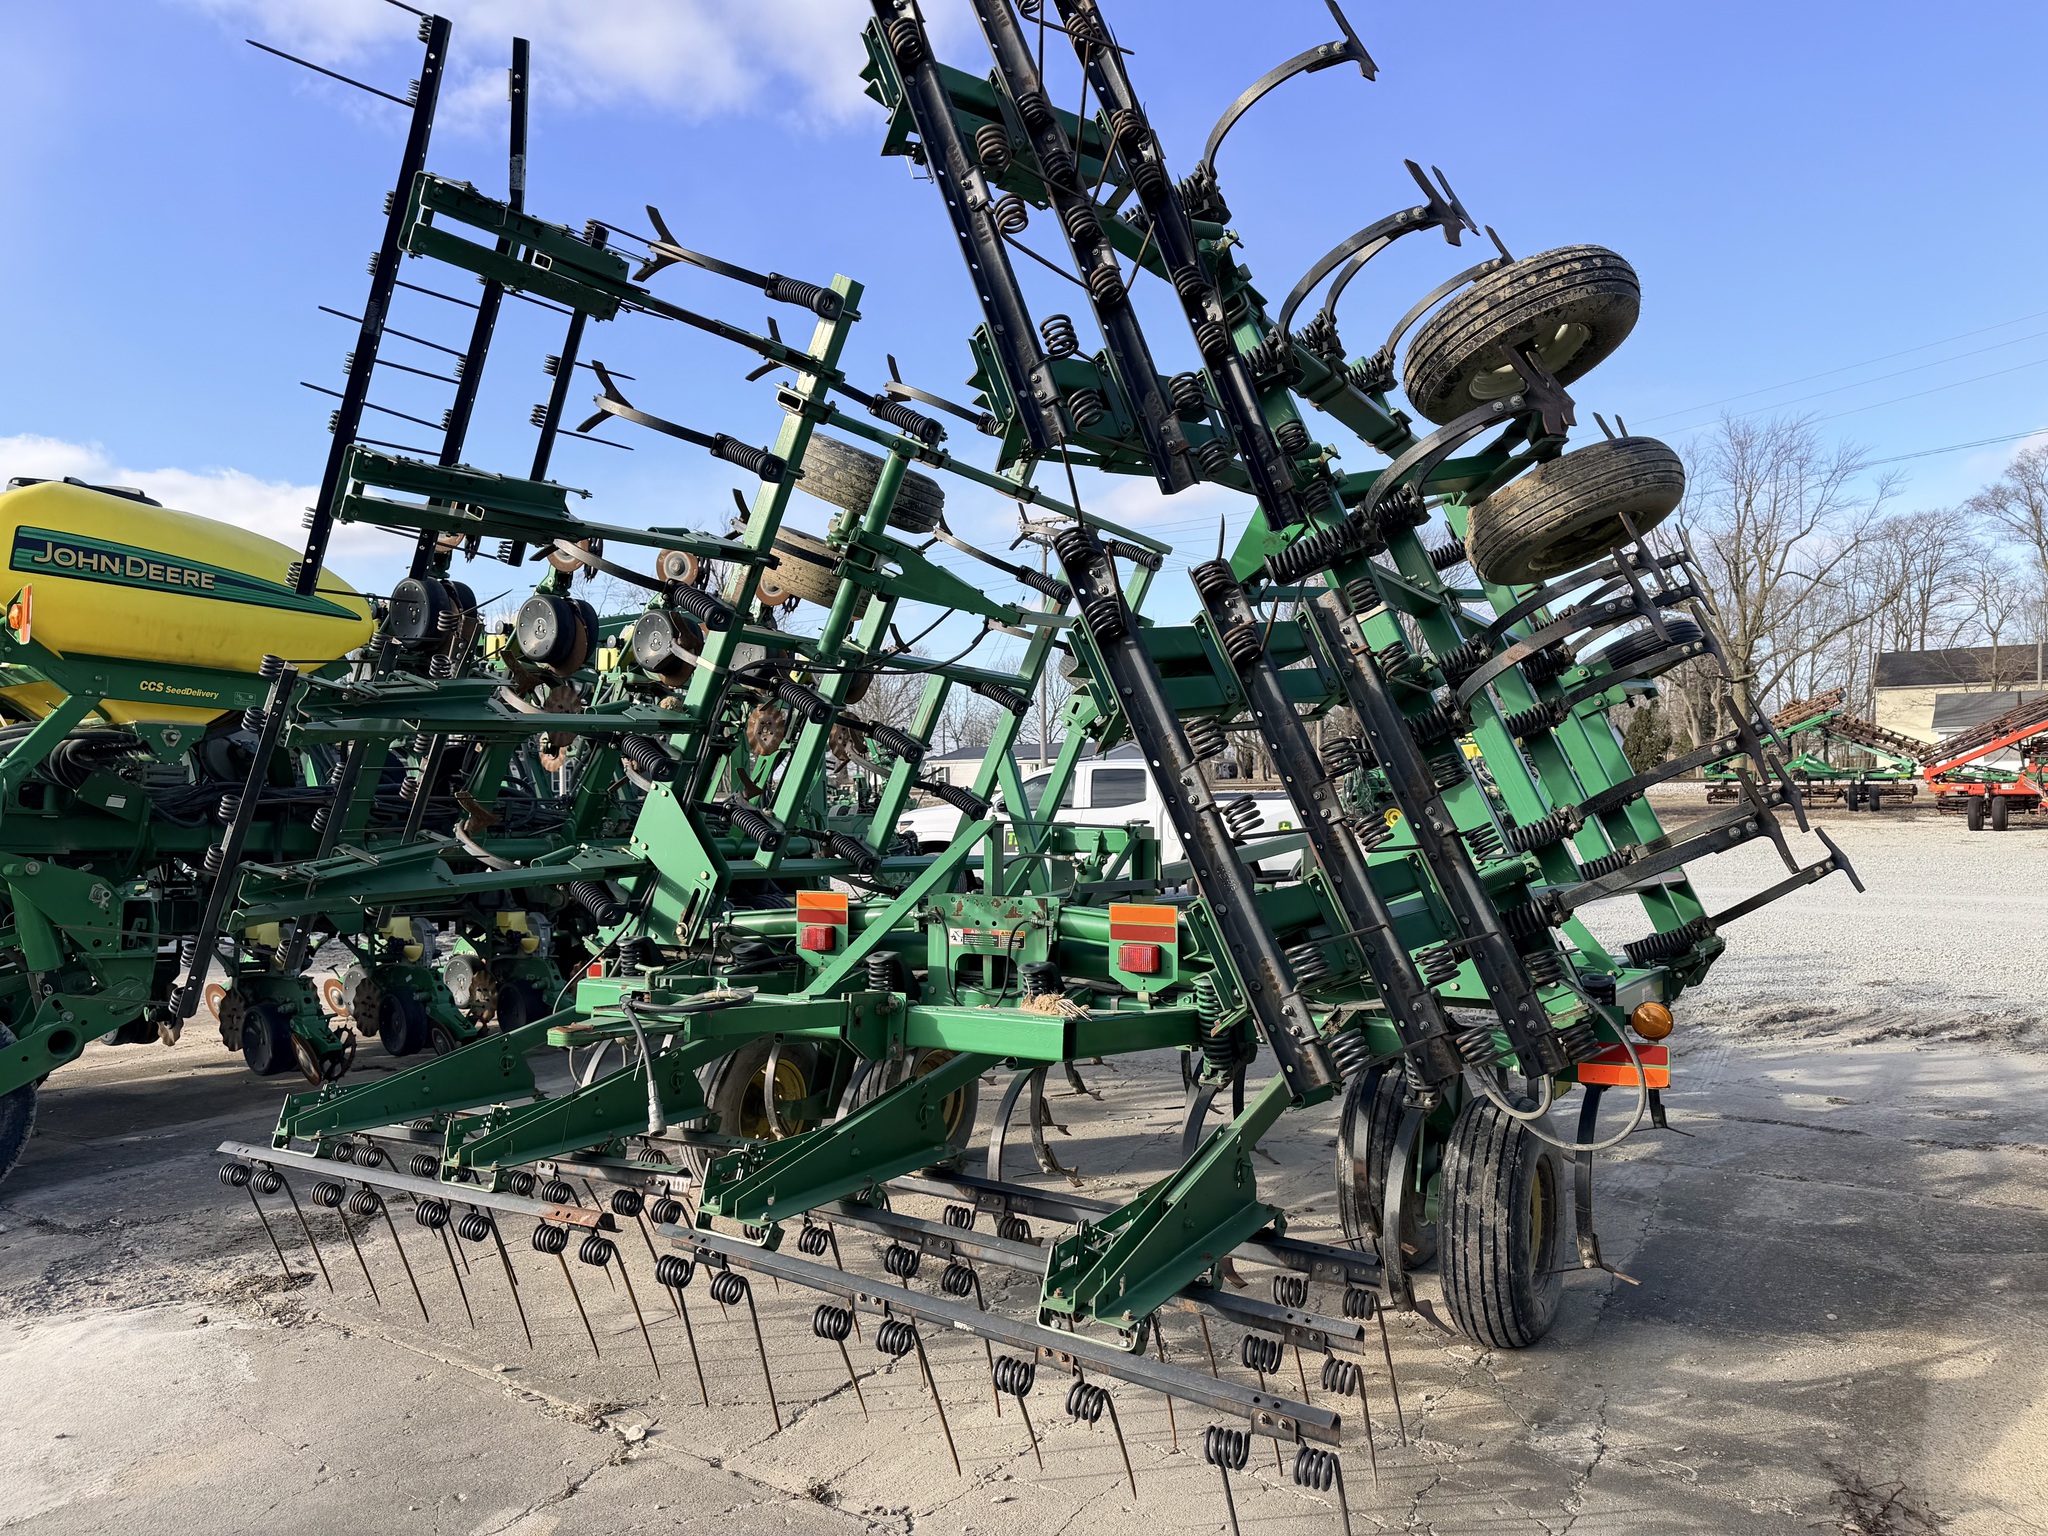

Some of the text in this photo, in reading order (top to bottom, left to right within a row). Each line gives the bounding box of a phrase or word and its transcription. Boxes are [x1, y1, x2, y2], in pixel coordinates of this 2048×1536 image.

[34, 541, 216, 590] JOHN DEERE
[139, 680, 165, 693] CCS
[165, 685, 220, 700] SeedDelivery
